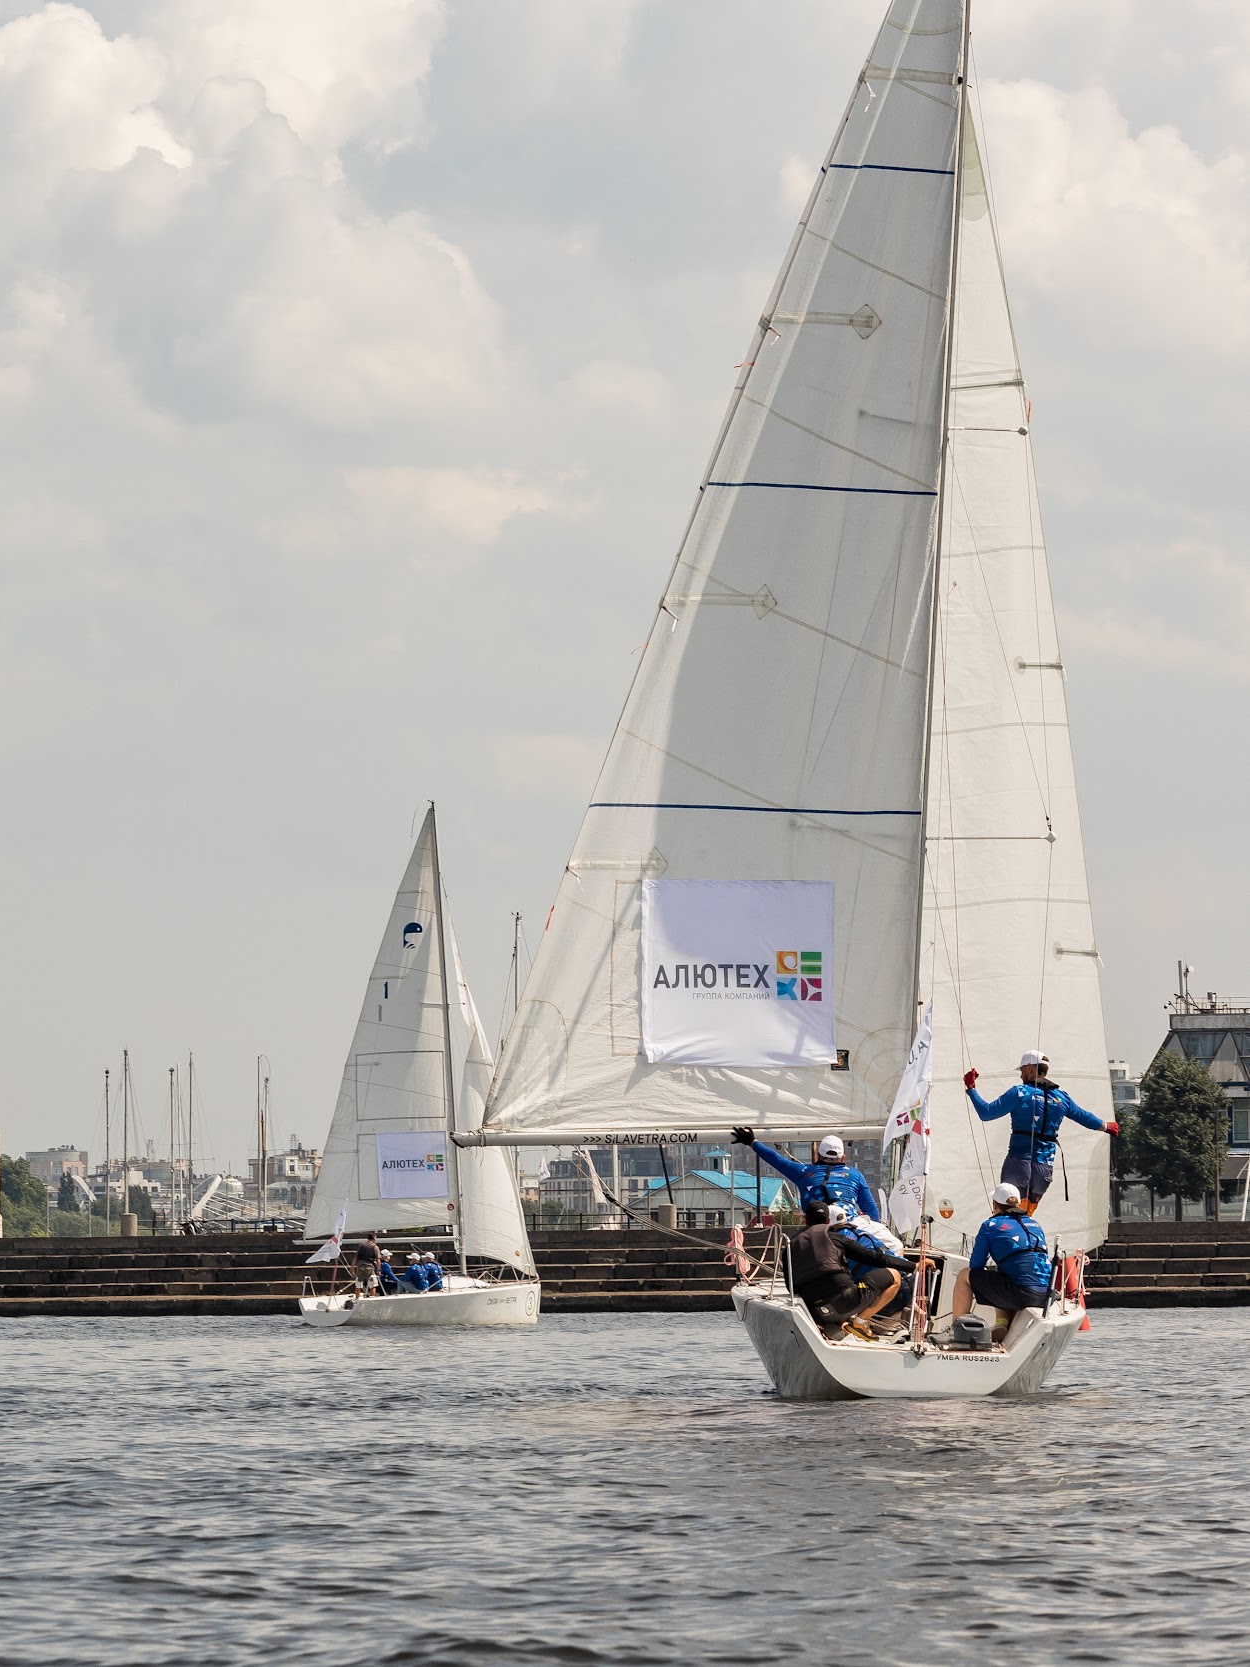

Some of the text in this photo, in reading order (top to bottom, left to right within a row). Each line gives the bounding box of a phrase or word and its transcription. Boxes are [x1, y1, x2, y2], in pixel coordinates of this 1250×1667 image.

[653, 963, 771, 989] АЛЮТЕХ
[384, 981, 388, 999] 1
[692, 991, 770, 1000] ГРУППА КОМПАНИЙ
[381, 1159, 425, 1169] АЛЮТЕХ
